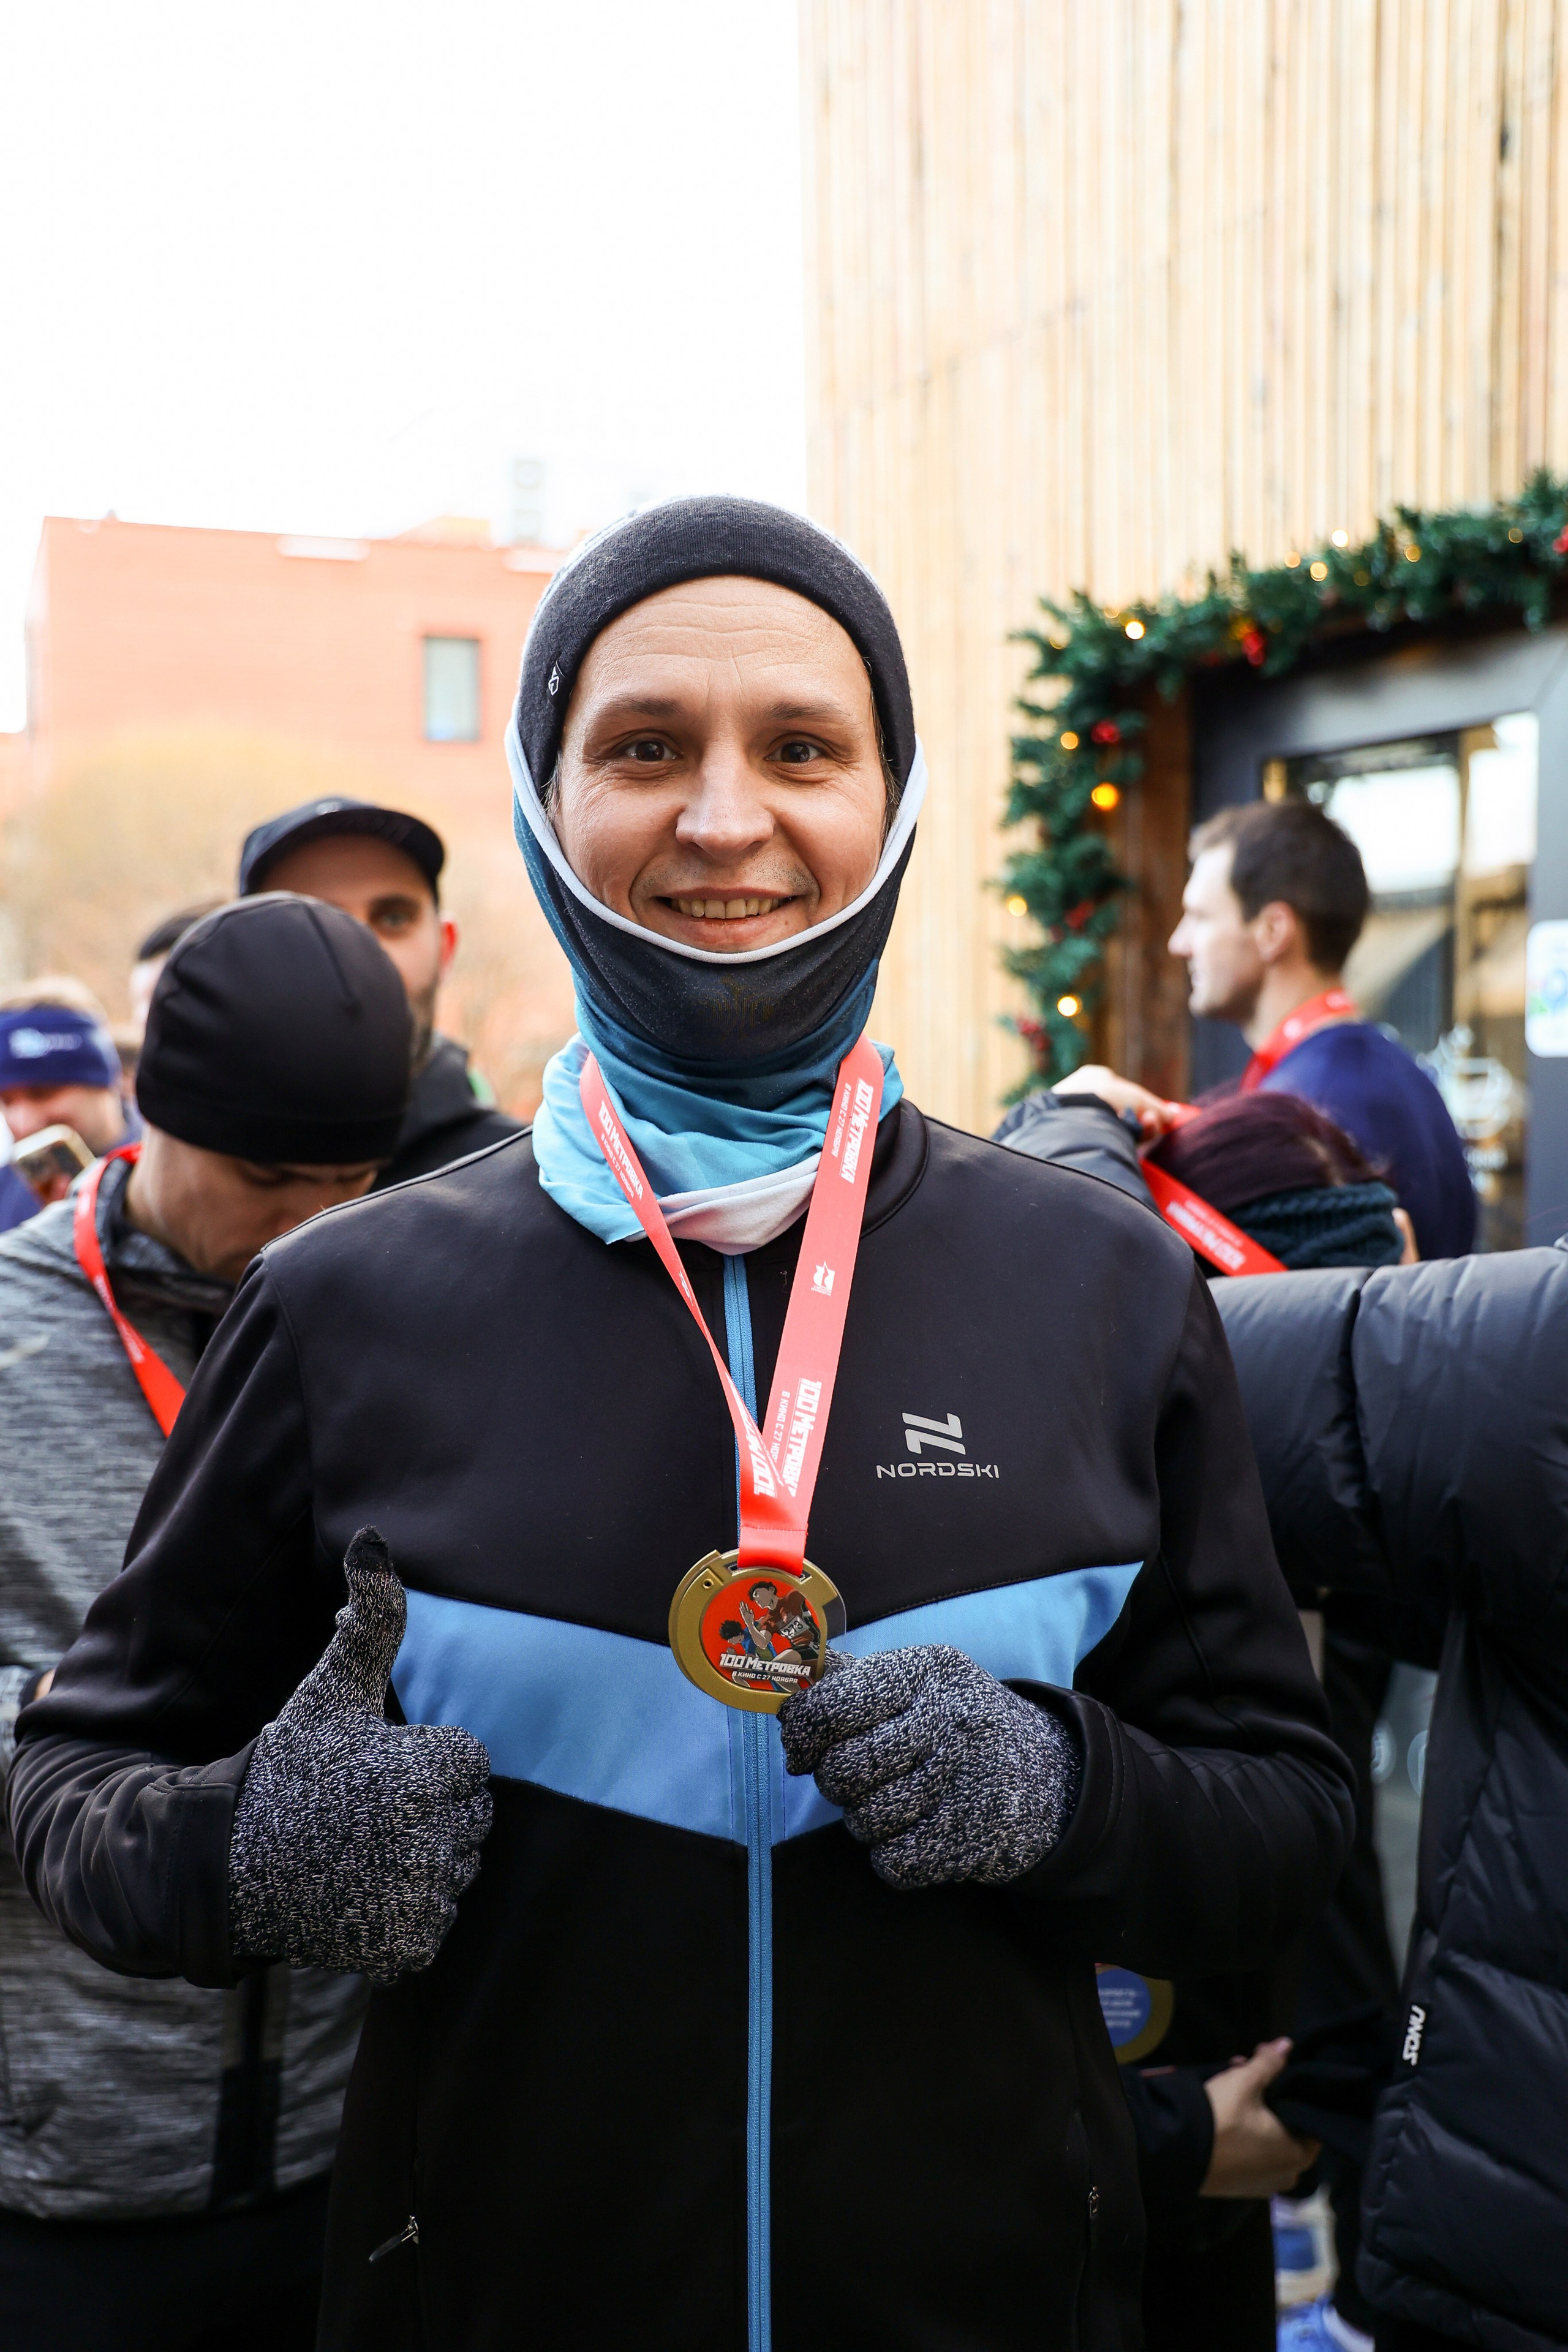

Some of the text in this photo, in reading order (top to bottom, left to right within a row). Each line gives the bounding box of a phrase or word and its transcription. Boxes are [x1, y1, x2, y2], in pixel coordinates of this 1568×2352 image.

[841, 1090, 850, 1111] КИНО
[838, 1115, 845, 1128] 27
[831, 1125, 843, 1158] НОЯБРЯ
[615, 1161, 621, 1171] 27
[777, 1399, 789, 1422] КИНО
[774, 1431, 783, 1442] 27
[876, 1463, 1000, 1479] NORDSKI
[783, 1621, 804, 1637] 273
